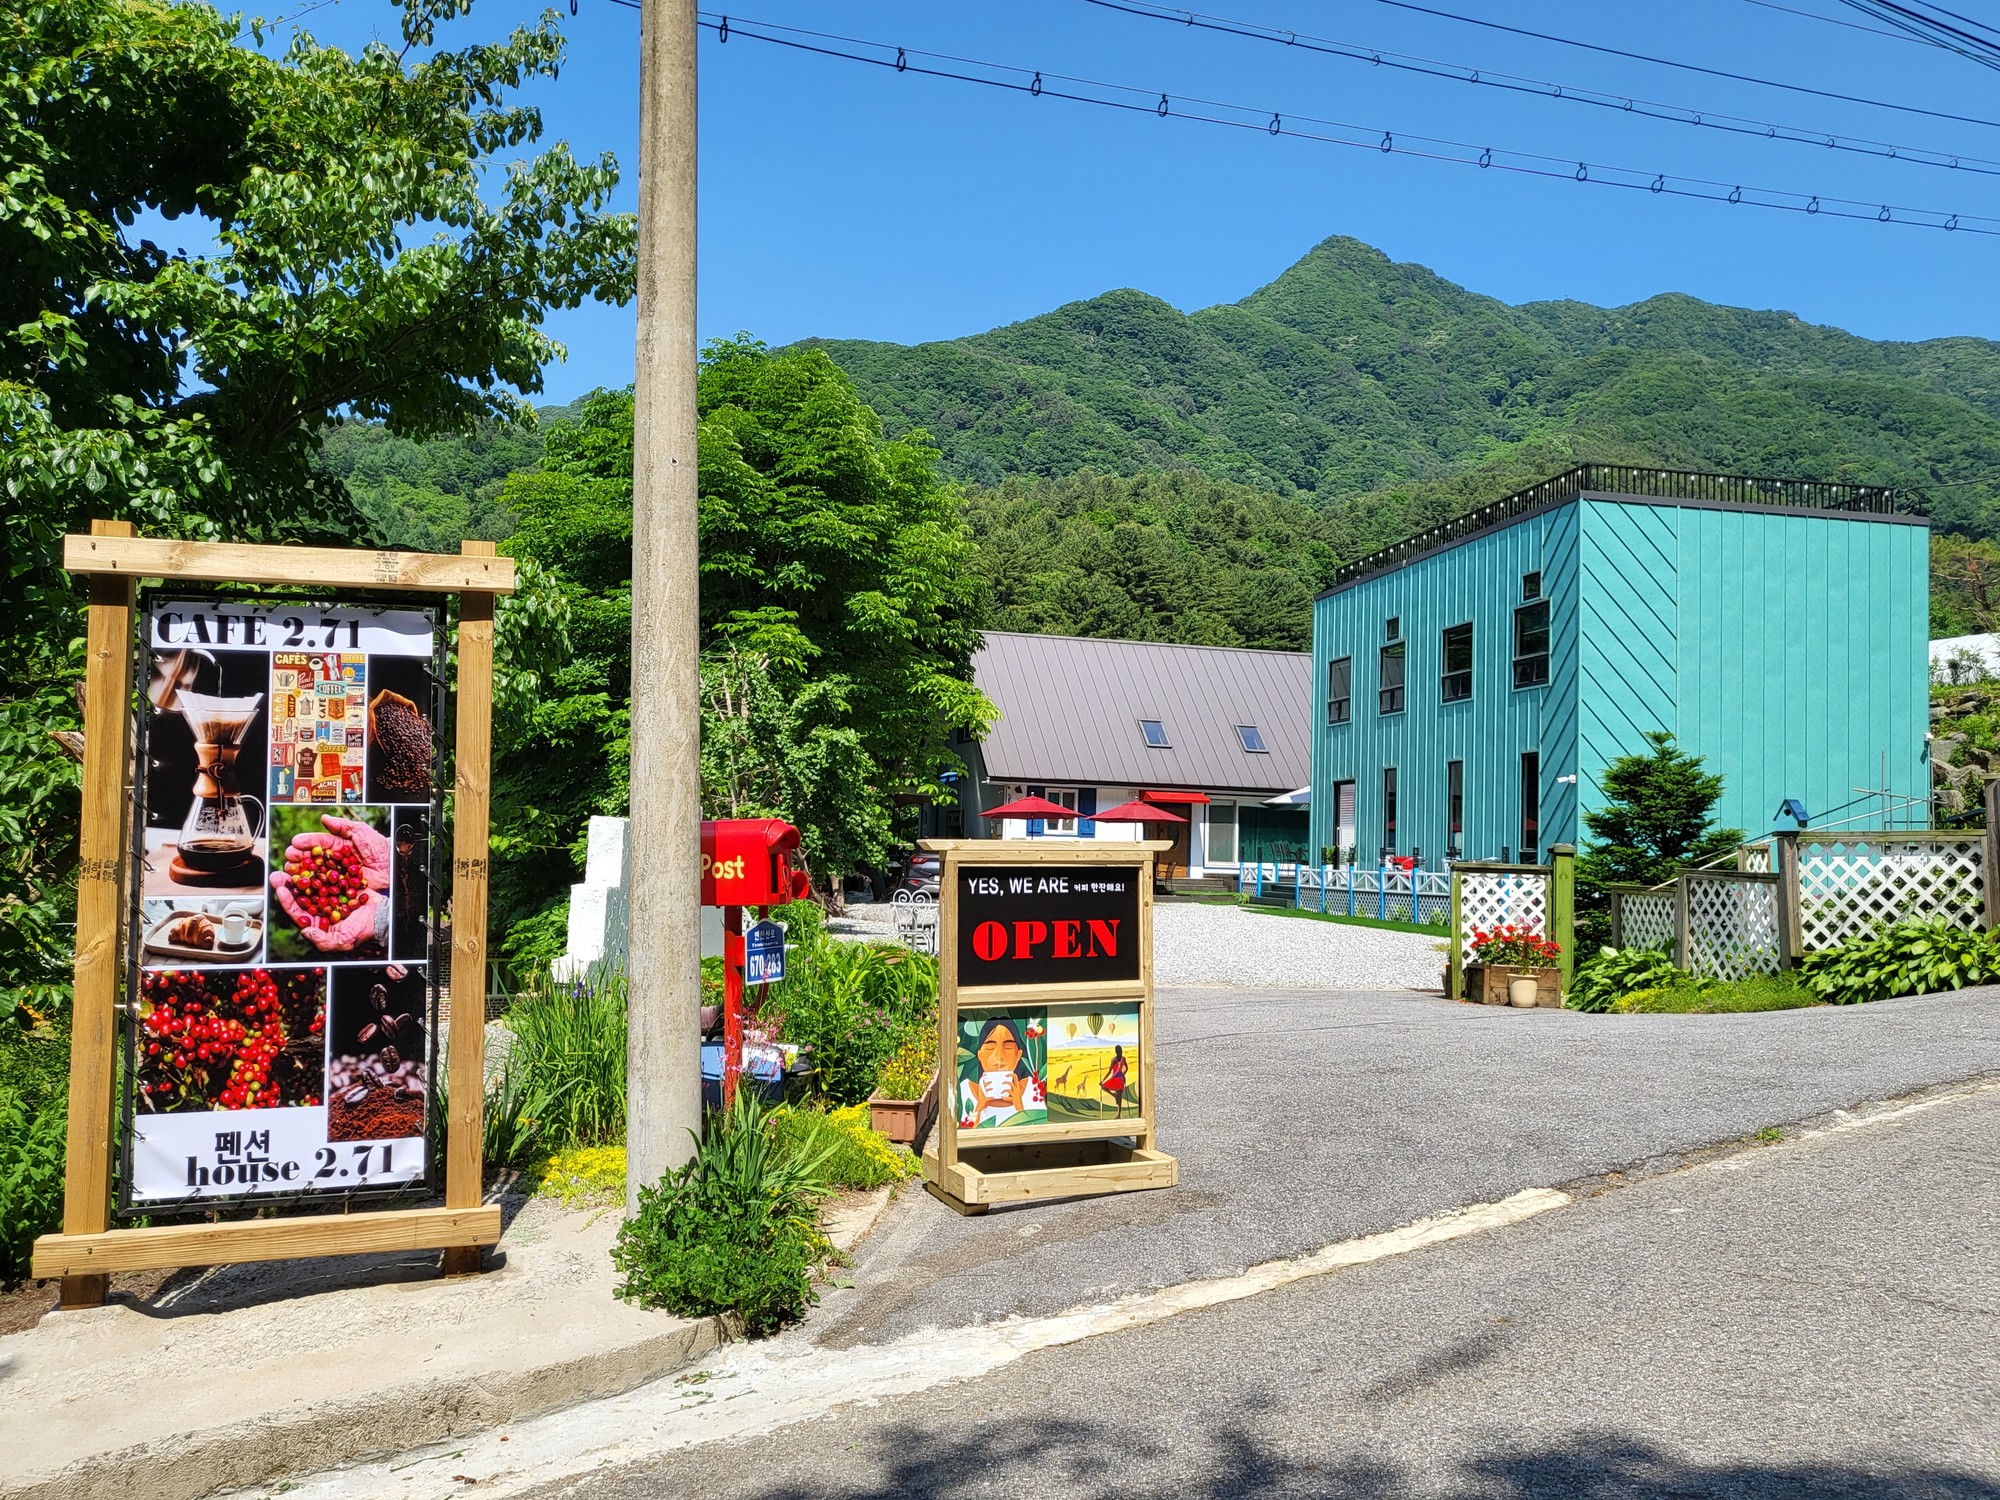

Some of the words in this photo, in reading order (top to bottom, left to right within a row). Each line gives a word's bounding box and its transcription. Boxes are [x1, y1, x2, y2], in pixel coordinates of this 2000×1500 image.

[157, 608, 267, 645] CAFÉ
[282, 616, 361, 649] 2.71
[318, 683, 345, 695] COFFEE
[701, 853, 745, 880] Post
[968, 877, 1004, 897] YES,
[1009, 877, 1033, 894] WE
[1037, 876, 1069, 894] ARE
[1073, 882, 1089, 892] 커피
[972, 919, 1121, 962] OPEN
[750, 952, 782, 977] 670283
[214, 1129, 270, 1165] 펜션
[185, 1155, 301, 1187] house
[314, 1144, 395, 1179] 2.71
